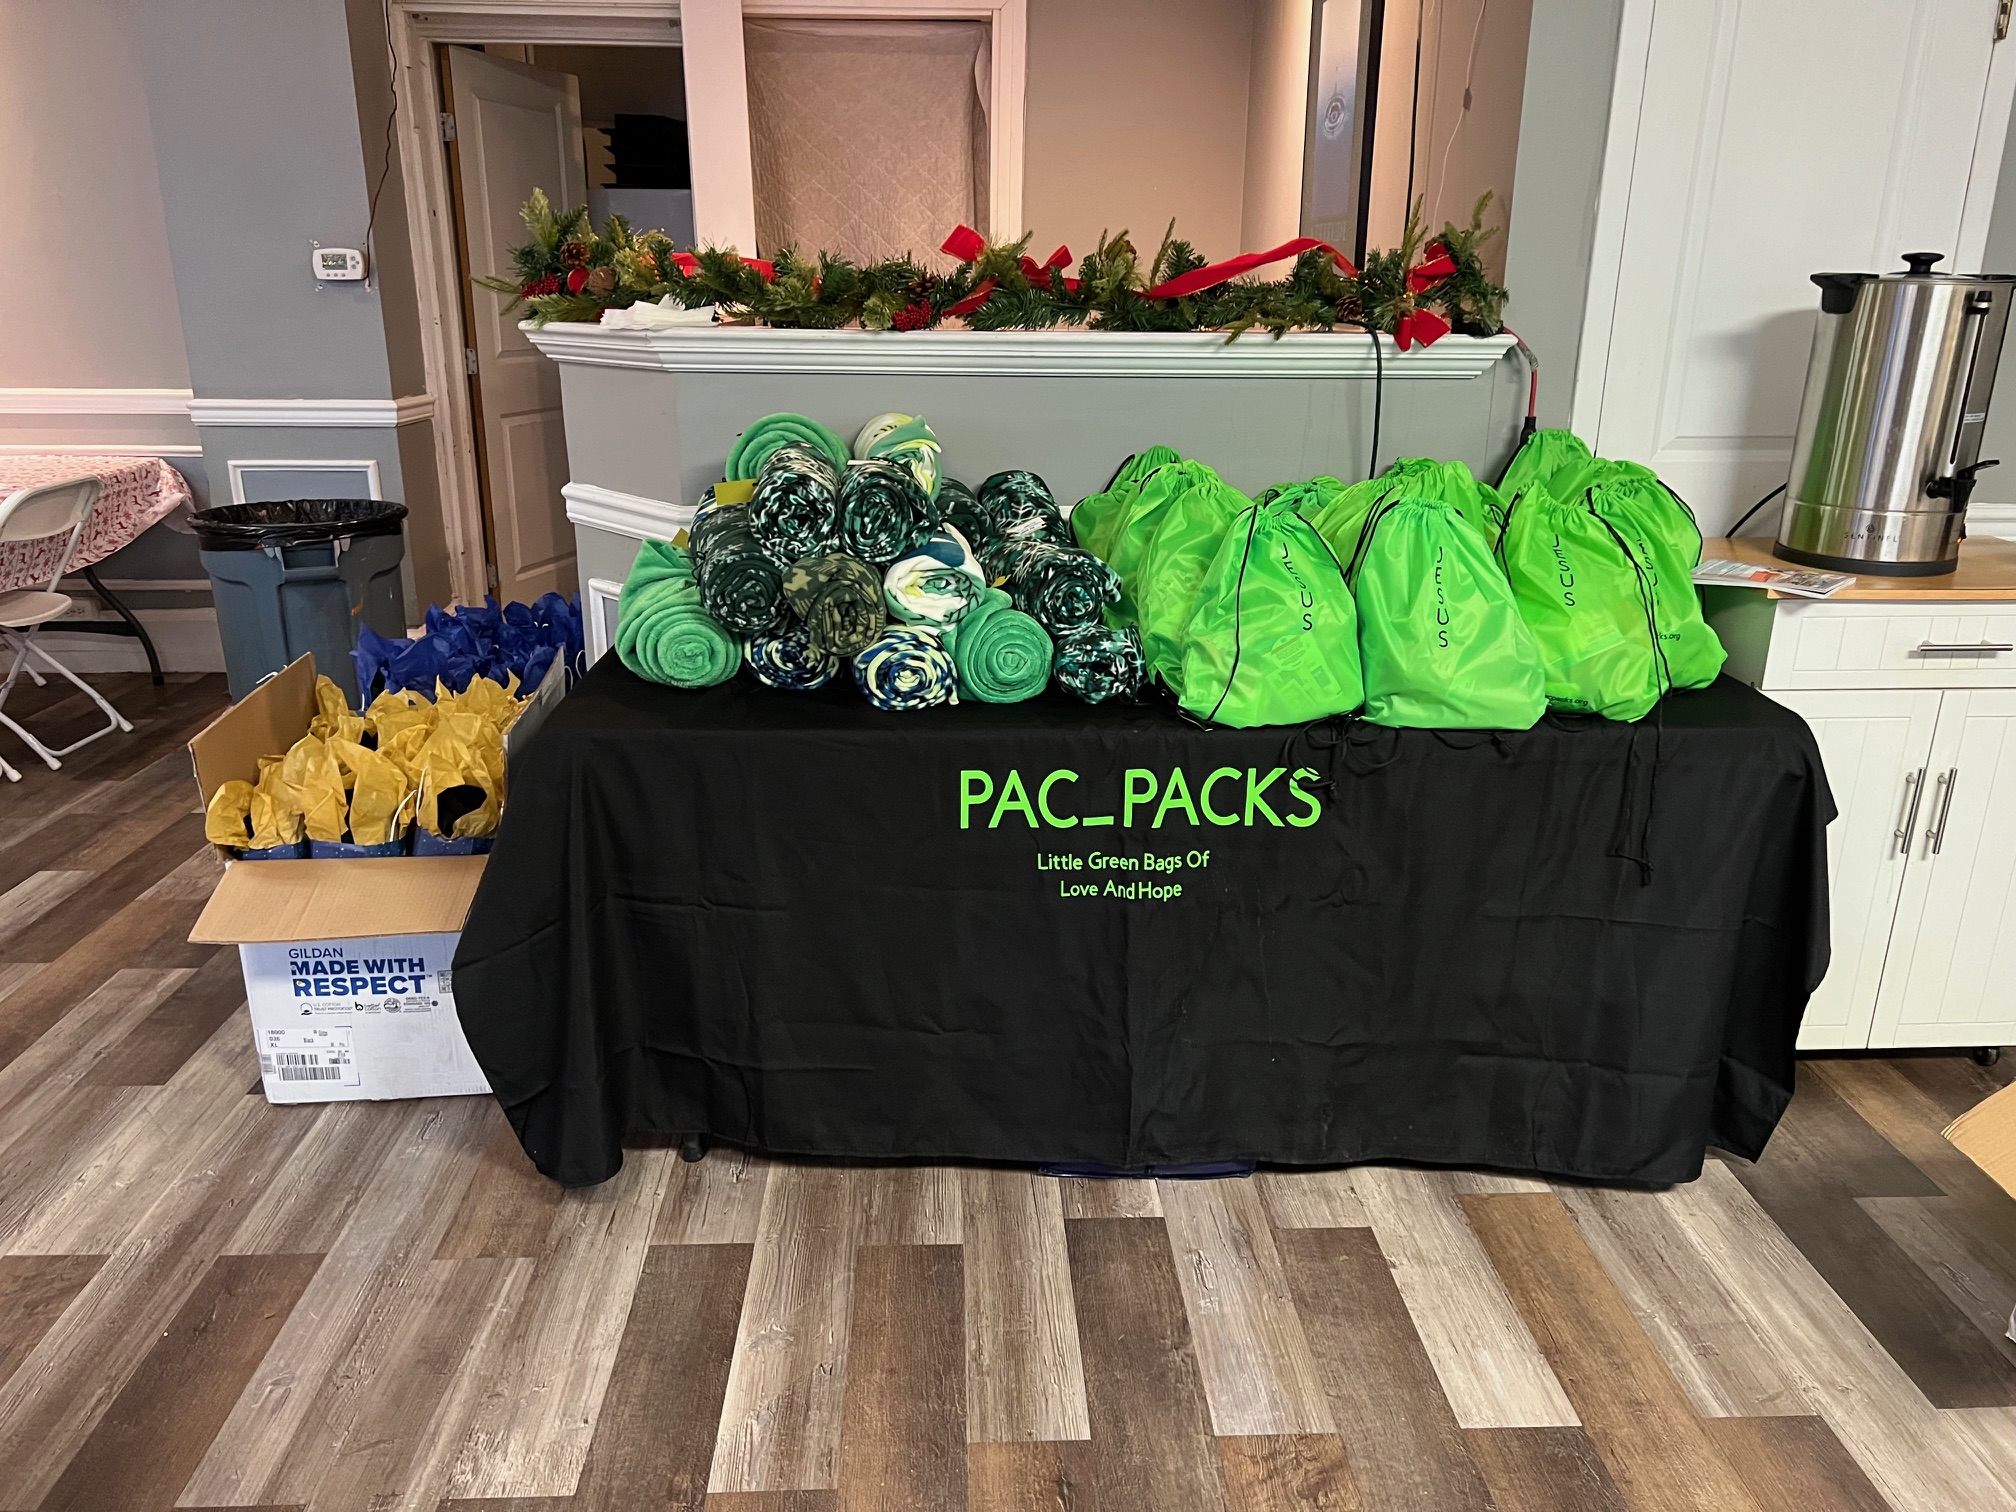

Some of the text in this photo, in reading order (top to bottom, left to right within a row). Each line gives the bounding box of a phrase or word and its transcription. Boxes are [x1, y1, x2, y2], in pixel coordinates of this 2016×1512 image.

[1552, 534, 1576, 607] JESUS
[1282, 542, 1313, 631] JESUS
[1435, 546, 1449, 648] JESUS
[1037, 850, 1211, 874] Little Green Bags Of
[1060, 880, 1183, 902] Love And Hope
[288, 948, 344, 959] GILDAN
[289, 957, 425, 976] MADE WITH
